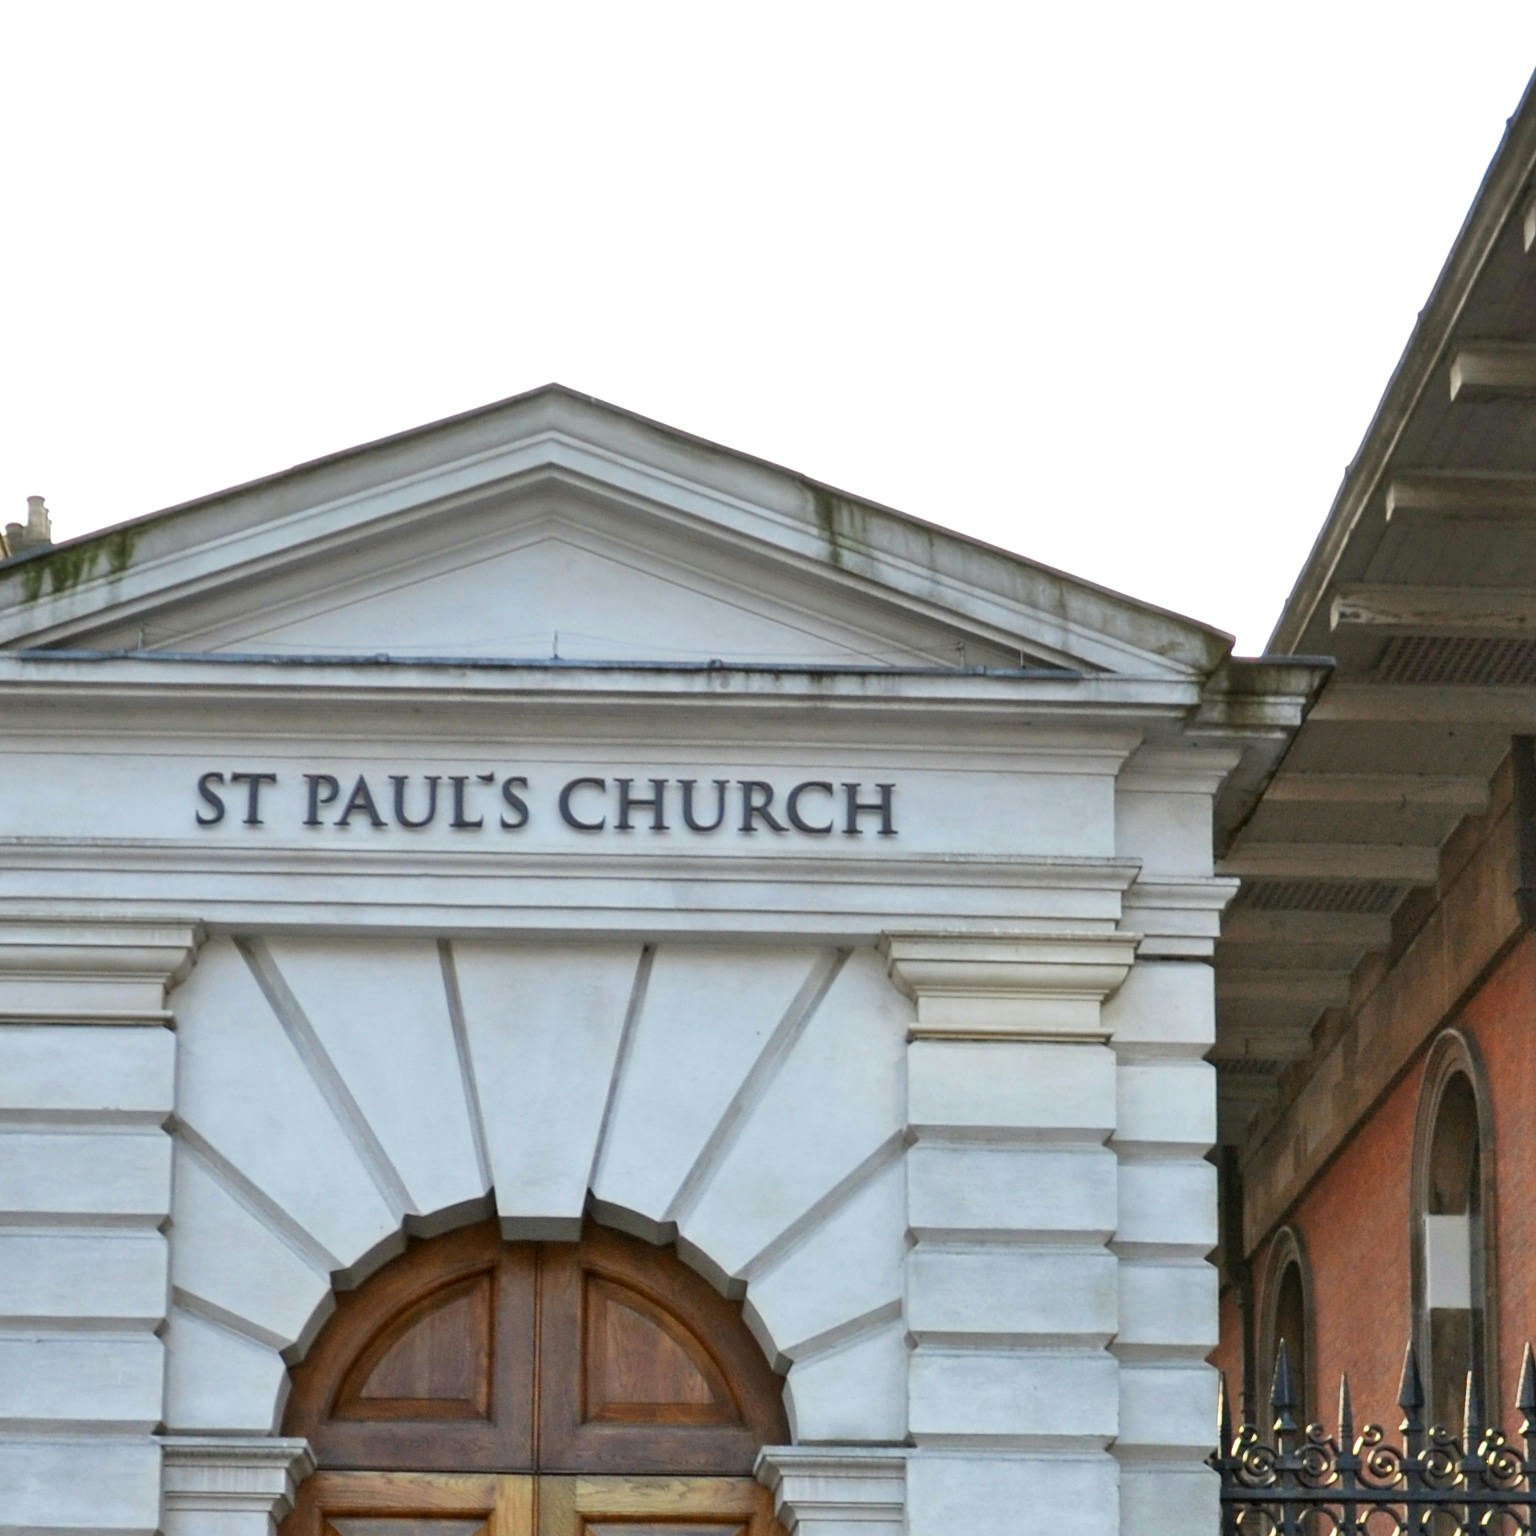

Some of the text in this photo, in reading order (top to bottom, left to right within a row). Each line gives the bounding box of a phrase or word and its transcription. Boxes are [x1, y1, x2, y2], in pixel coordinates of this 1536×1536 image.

[196, 771, 898, 835] ST PAUL'S CHURCH
